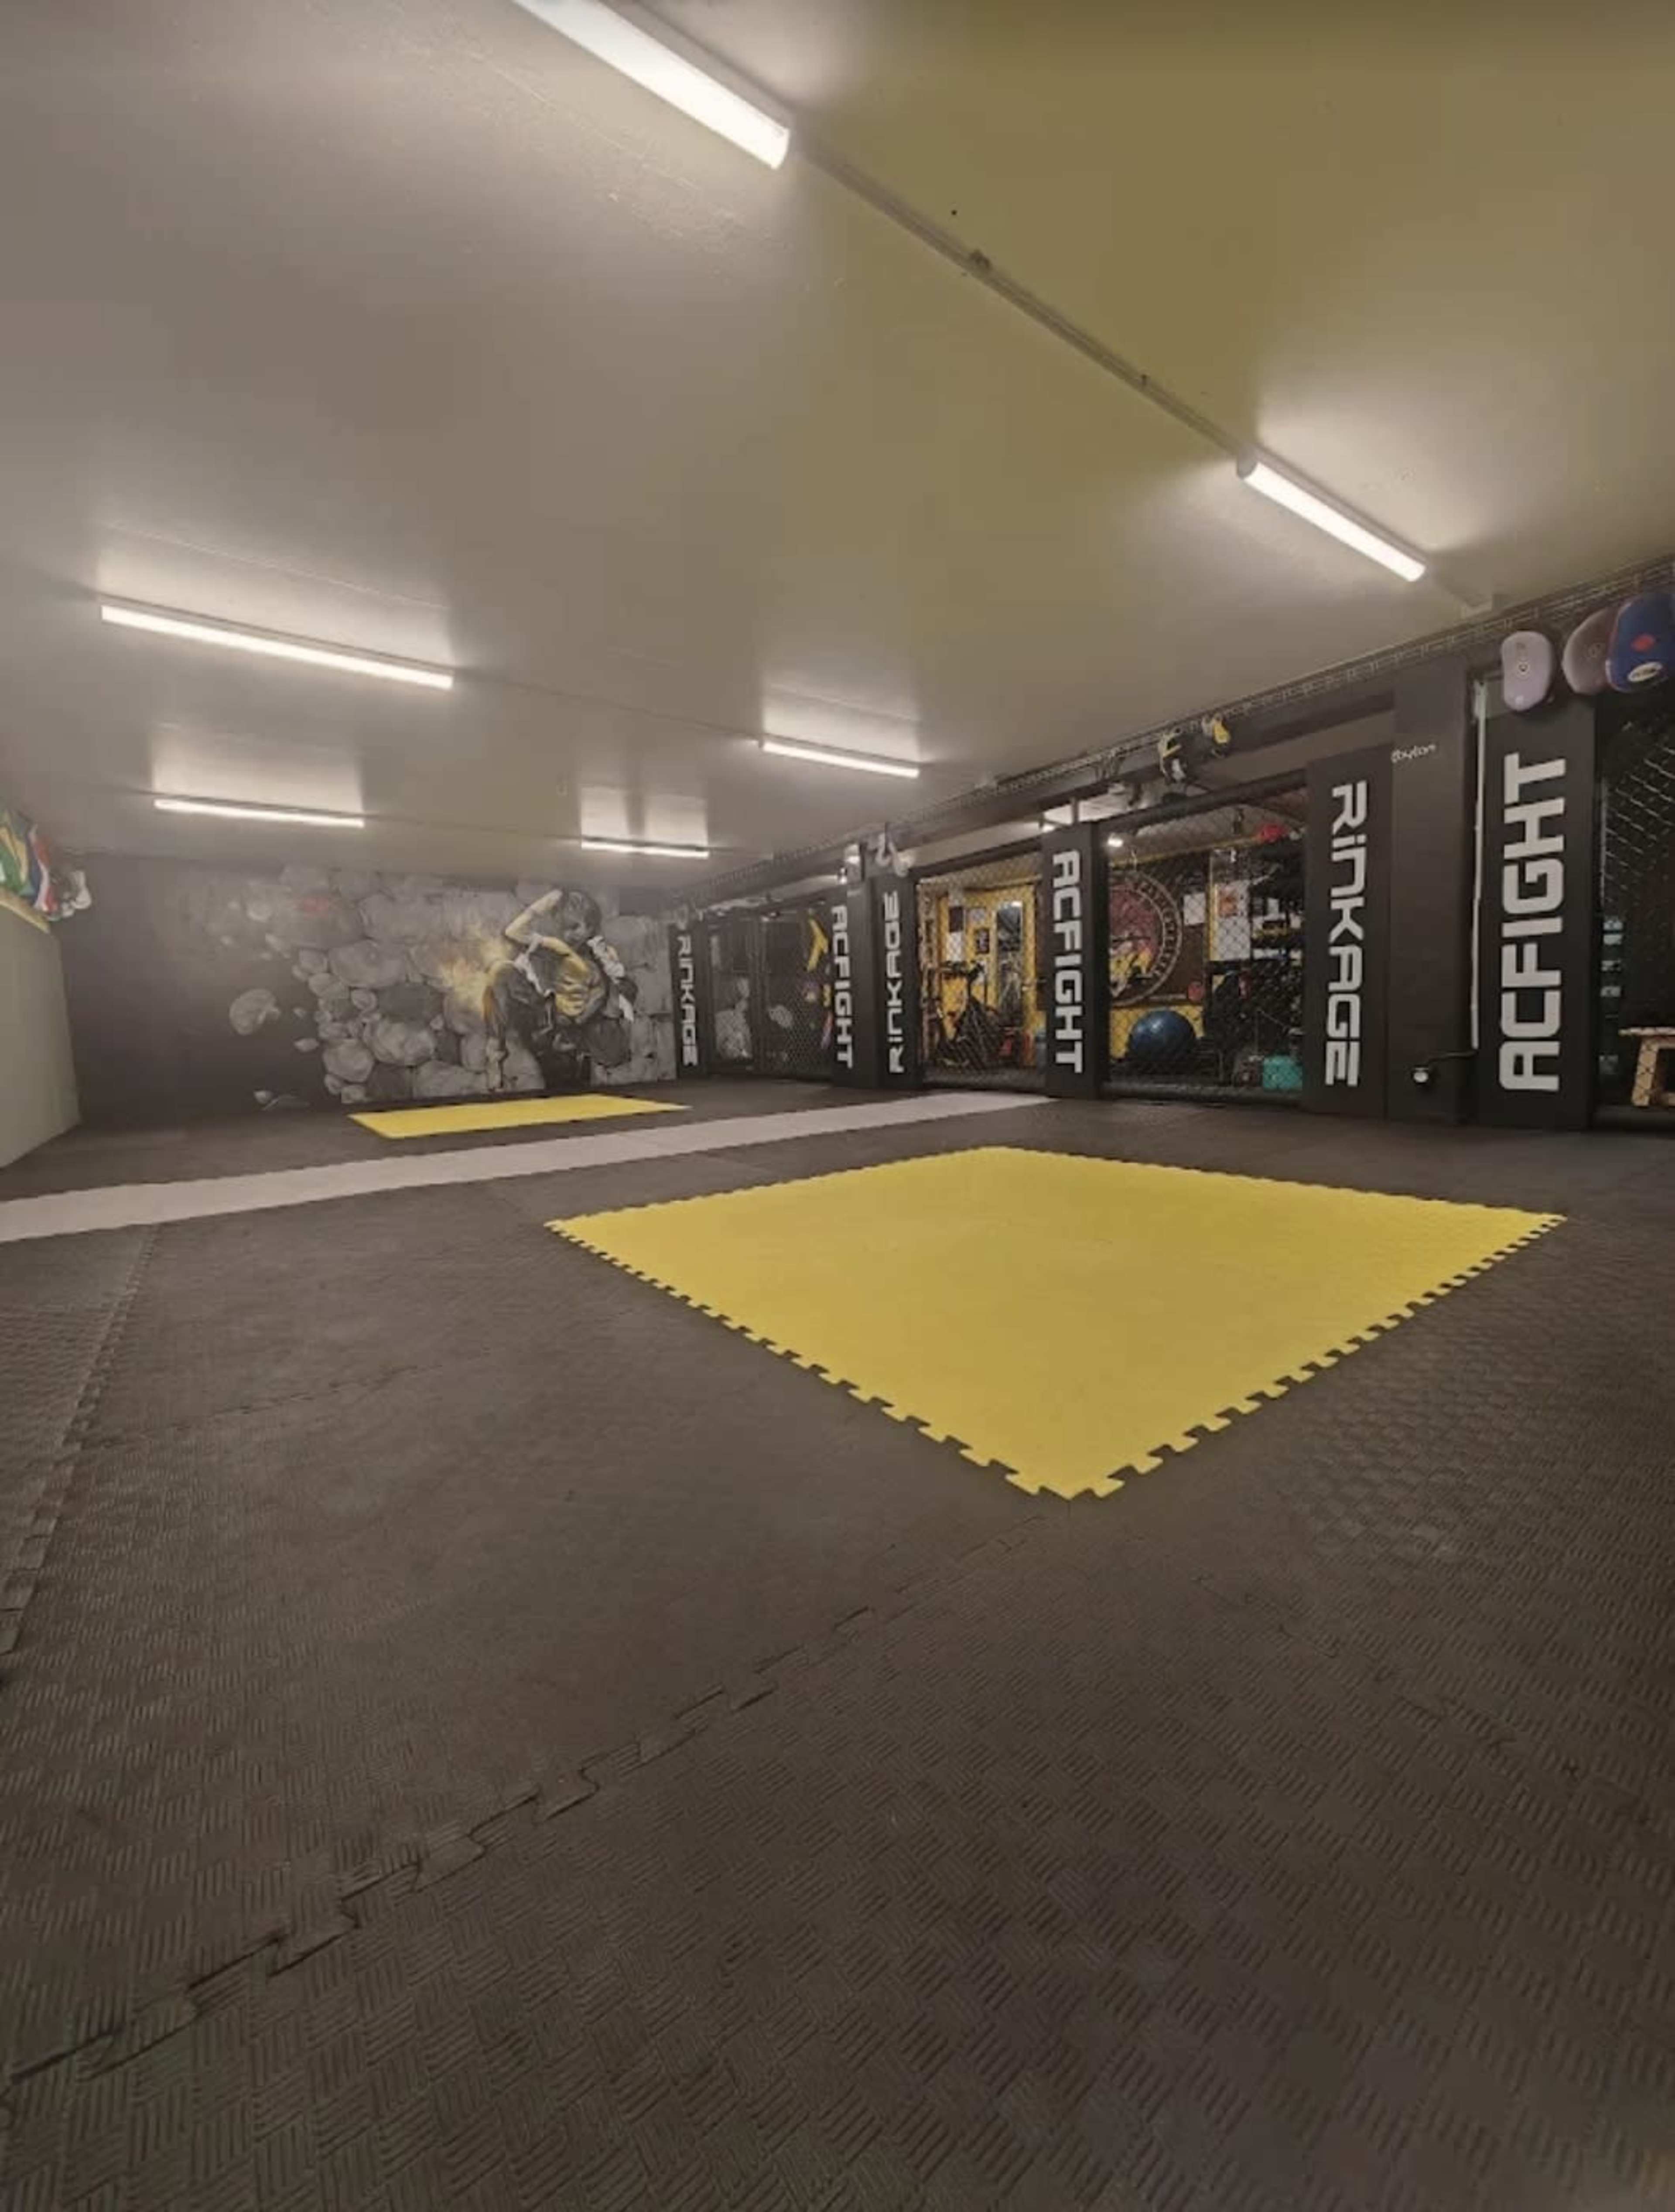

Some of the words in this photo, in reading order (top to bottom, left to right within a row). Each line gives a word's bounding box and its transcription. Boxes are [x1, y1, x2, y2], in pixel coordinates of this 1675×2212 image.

[831, 905, 853, 1068] ACFIGHT
[1053, 850, 1083, 1073] ACFIGHT
[1499, 752, 1566, 1091] ACFIGHT
